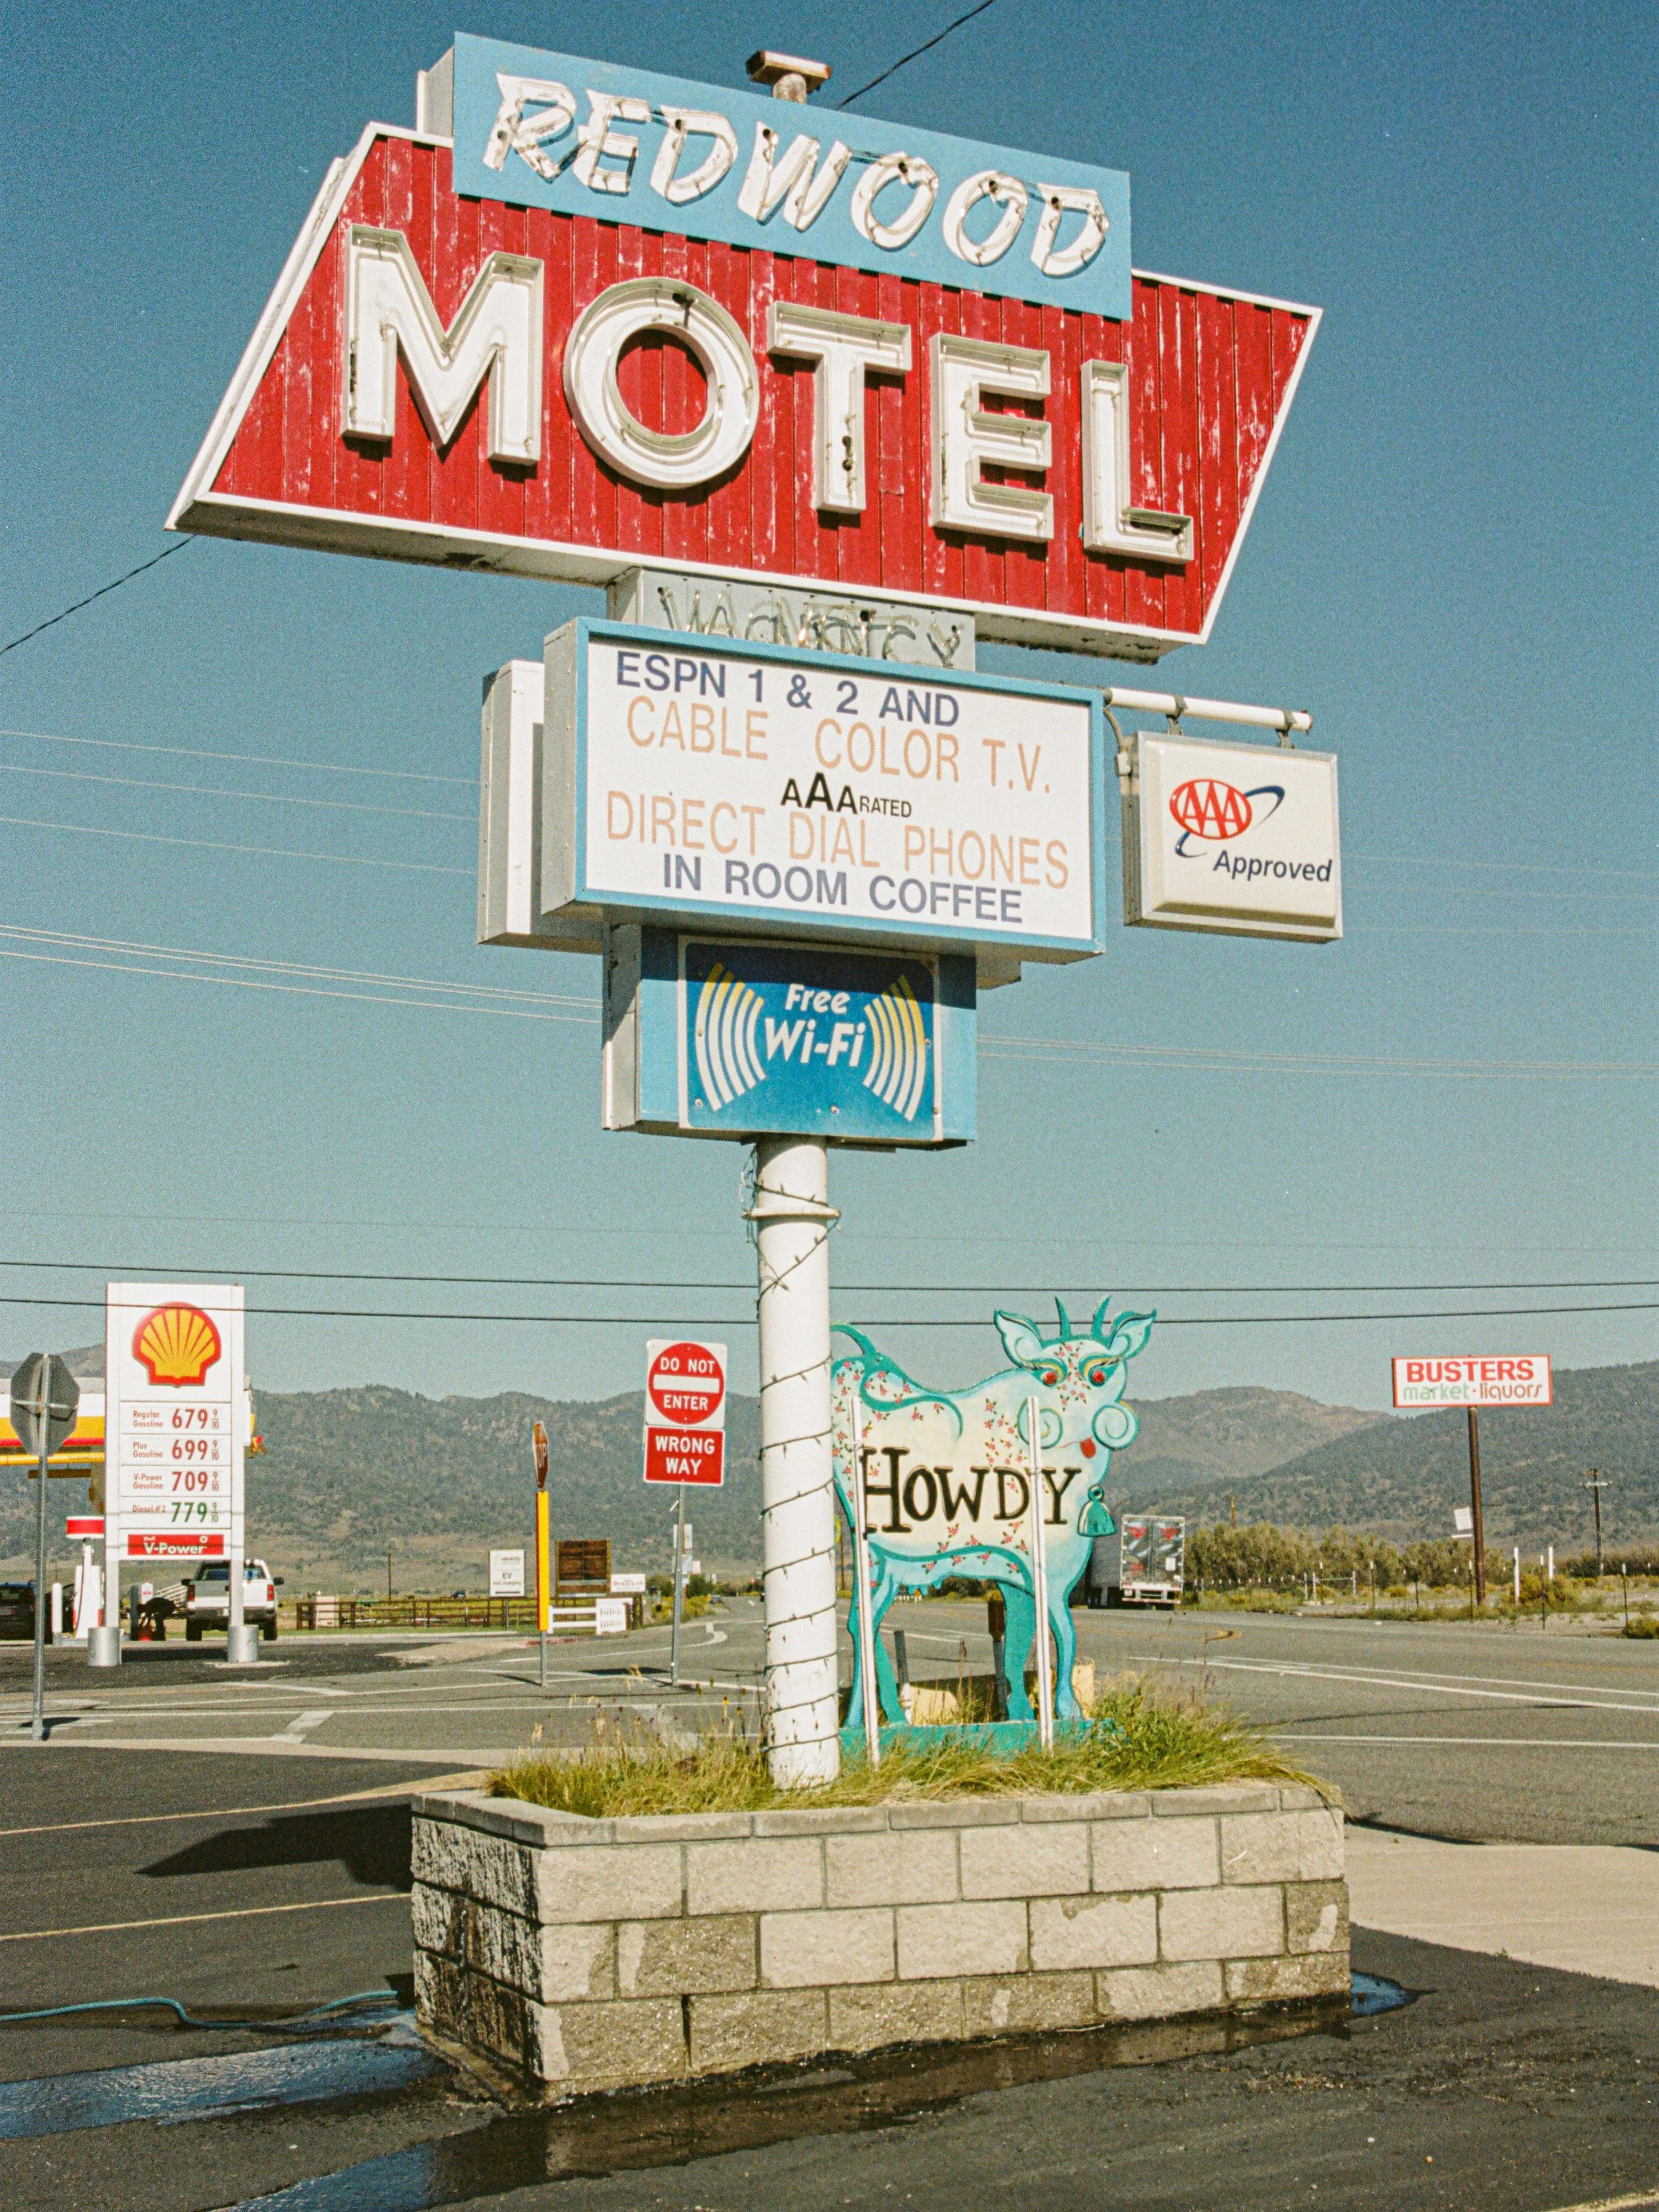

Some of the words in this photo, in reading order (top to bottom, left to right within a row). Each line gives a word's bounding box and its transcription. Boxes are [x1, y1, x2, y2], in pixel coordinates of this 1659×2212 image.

[481, 72, 1110, 279] REDWOOD
[340, 223, 1194, 565] MOTEL
[616, 651, 727, 698] ESPN
[748, 669, 764, 703] 1
[786, 674, 813, 710] &
[836, 680, 859, 716] 2
[879, 687, 960, 727] AND
[627, 695, 769, 761] CABLE
[815, 717, 960, 784] COLOR
[983, 738, 1050, 794] T.V.
[780, 771, 859, 816] AAA
[859, 794, 913, 819] RATED
[1179, 779, 1249, 840] AAA
[607, 790, 766, 856] DIRECT
[789, 810, 881, 869] DIAL
[904, 825, 1069, 890] PHONES
[1213, 849, 1333, 883] Approved
[663, 853, 702, 892] IN
[725, 860, 847, 907] ROOM
[869, 875, 1024, 925] COFFEE
[784, 983, 851, 1015] Free
[764, 1017, 867, 1067] Wi-Fi
[660, 1357, 680, 1372] DO
[687, 1359, 715, 1374] NOT
[1406, 1359, 1535, 1383] BUSTERS
[664, 1394, 709, 1411] ENTER
[1403, 1382, 1470, 1401] market
[1479, 1382, 1543, 1402] liquors
[133, 1410, 161, 1420] Regular
[133, 1419, 164, 1428] Gasoline
[171, 1408, 209, 1429] 679
[133, 1441, 147, 1449] Plus
[133, 1449, 163, 1458] Gasoline
[171, 1439, 208, 1460] 699
[655, 1436, 715, 1455] WRONG
[133, 1473, 163, 1481] V-Power
[666, 1457, 702, 1476] WAY
[133, 1481, 164, 1490] Gasoline
[171, 1470, 209, 1492] 709
[132, 1504, 154, 1513] Diesel
[171, 1501, 208, 1523] 779
[143, 1542, 206, 1554] V-Power
